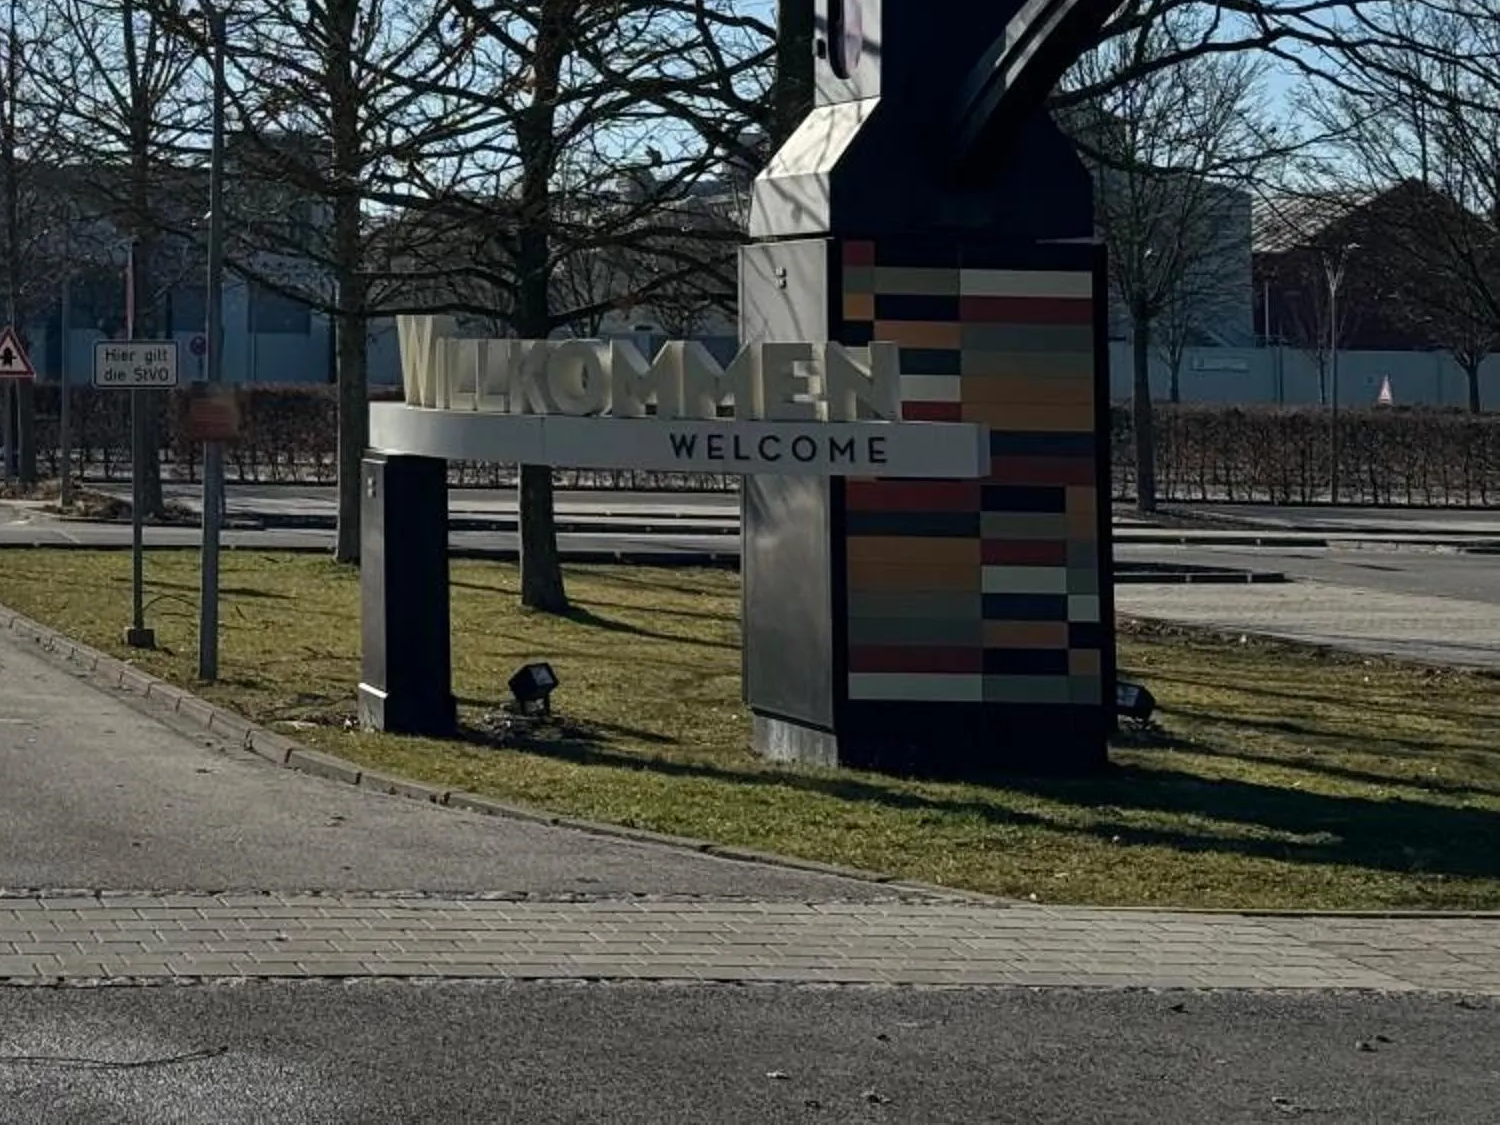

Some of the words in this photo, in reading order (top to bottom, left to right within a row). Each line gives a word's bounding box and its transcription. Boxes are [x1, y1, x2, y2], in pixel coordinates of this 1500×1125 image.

[105, 347, 136, 362] Hier
[145, 347, 168, 365] gilt
[397, 314, 901, 422] WILLKOMMEN
[104, 367, 127, 382] die
[134, 367, 169, 382] StVO
[670, 432, 888, 465] WELCOME
